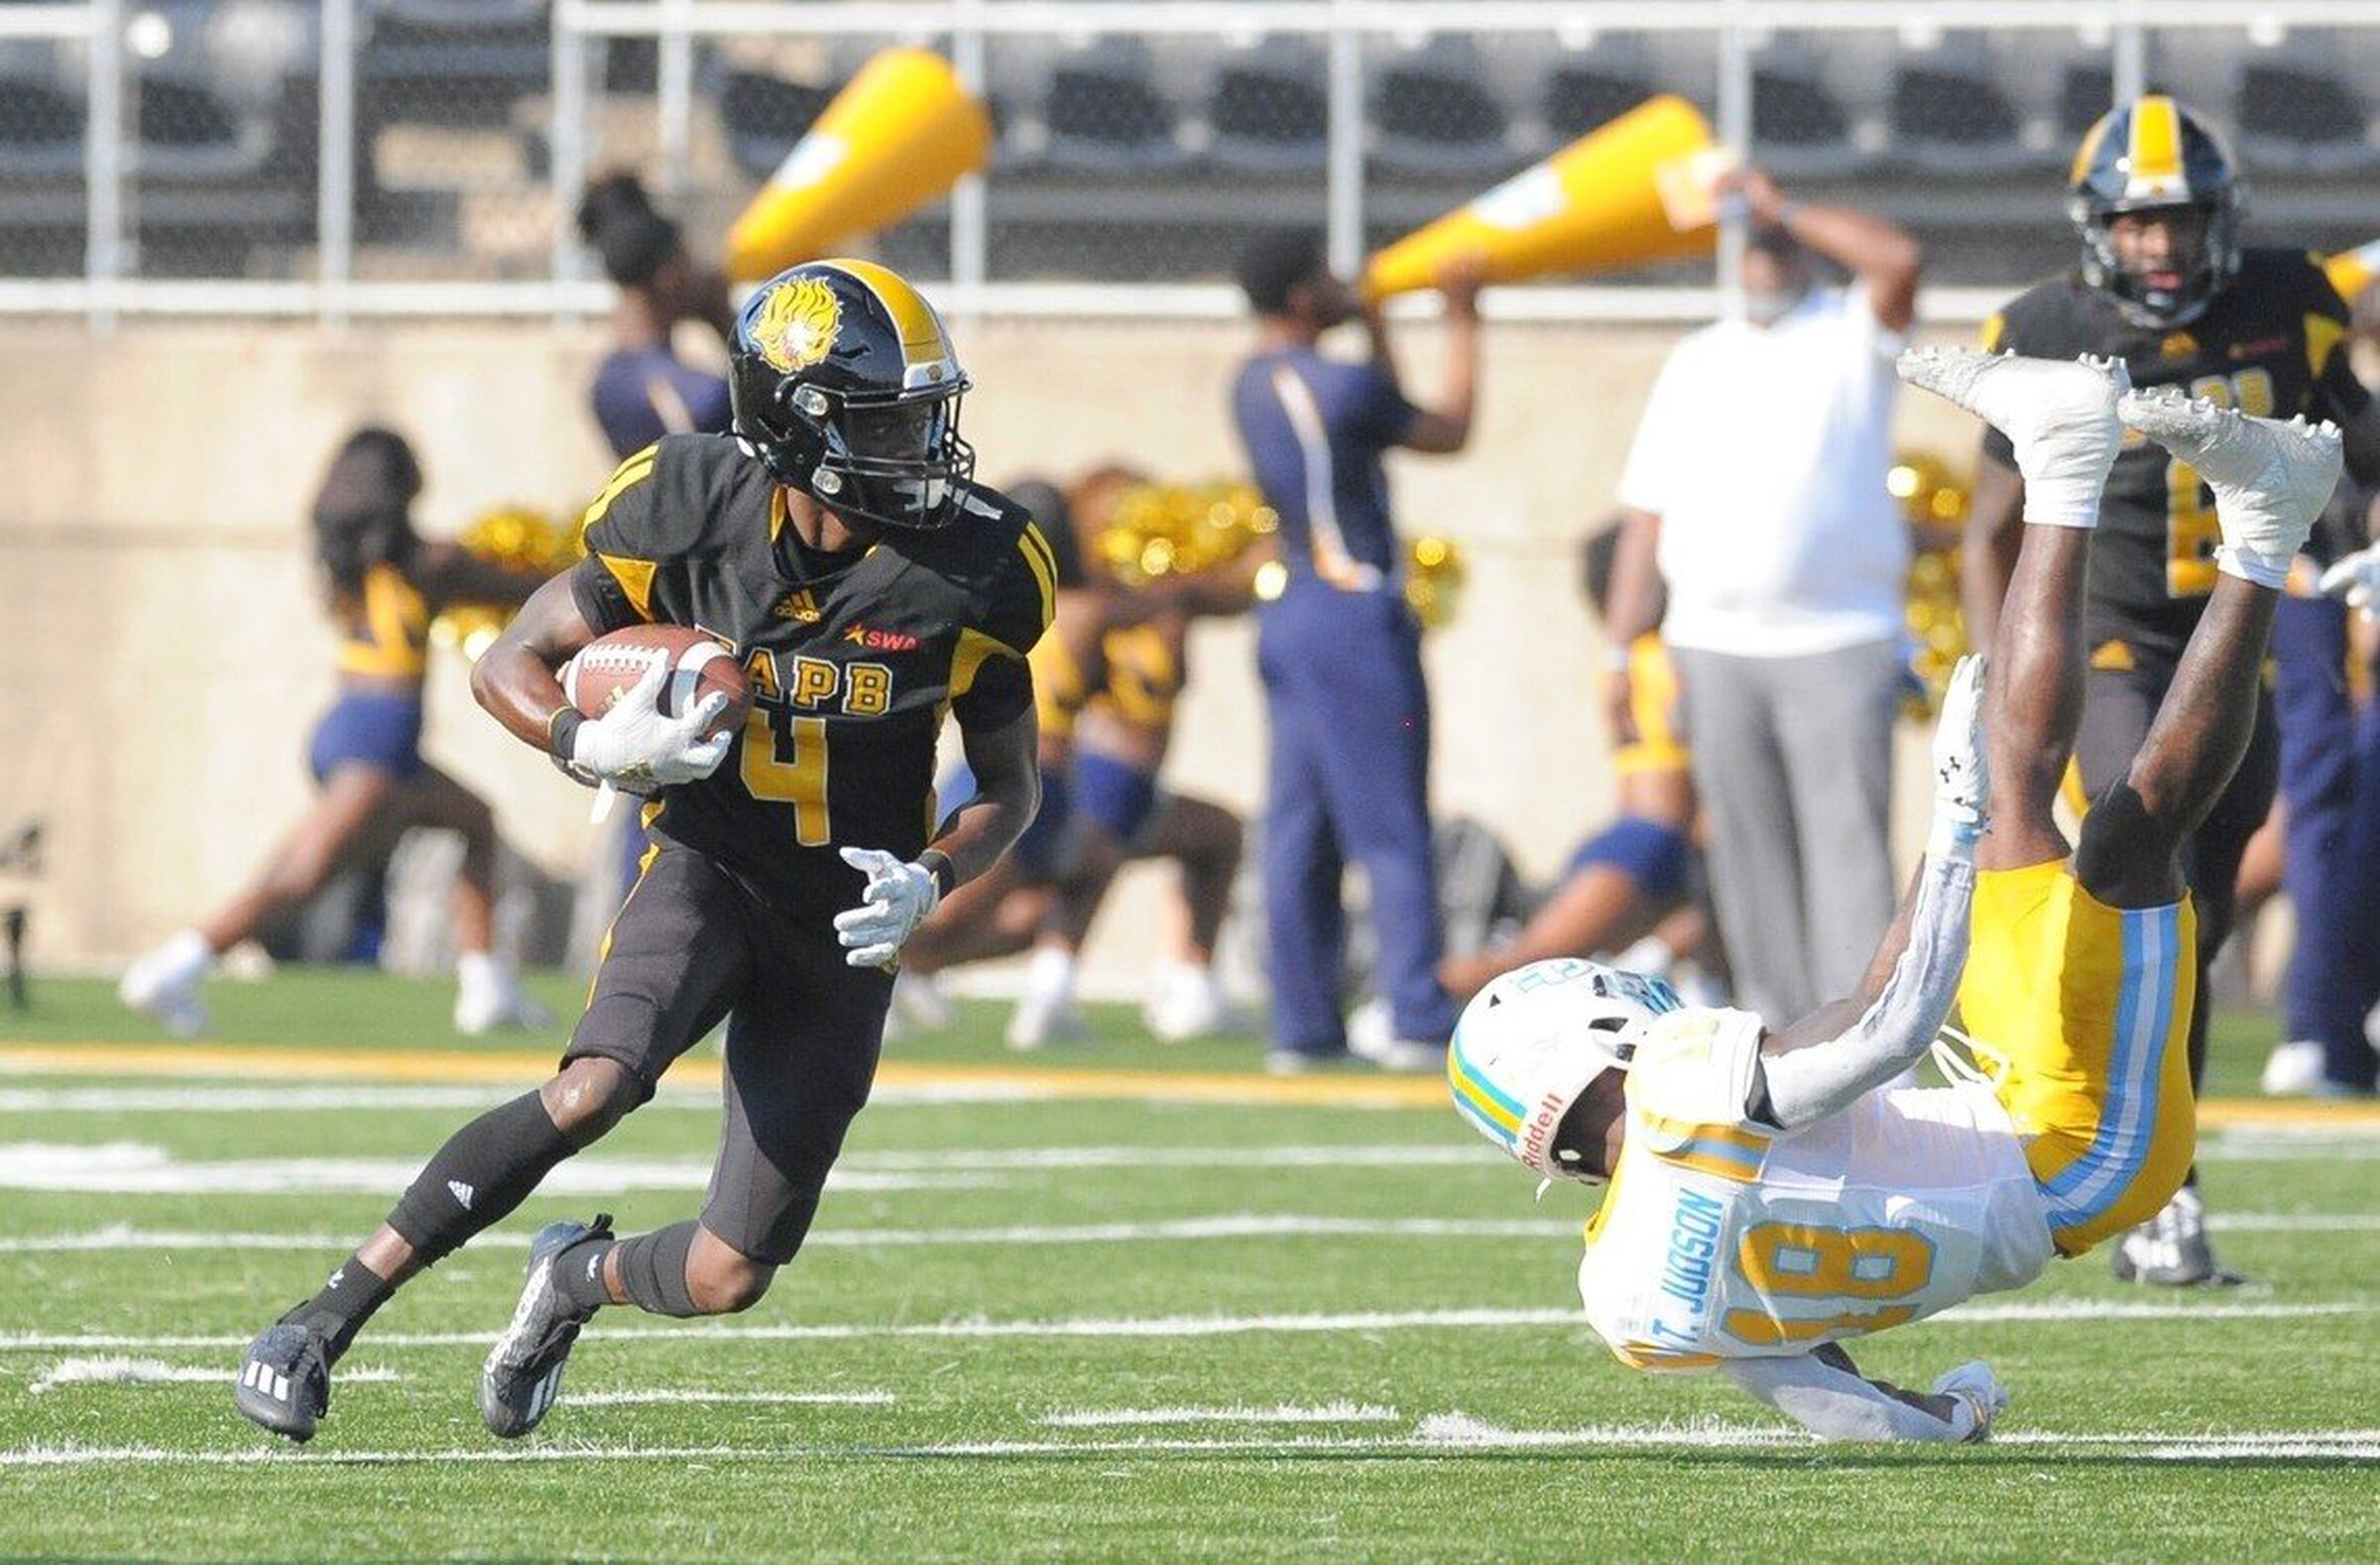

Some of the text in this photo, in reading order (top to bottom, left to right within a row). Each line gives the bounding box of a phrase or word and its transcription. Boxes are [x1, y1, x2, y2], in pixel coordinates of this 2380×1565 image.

[694, 623, 892, 715] APB
[740, 706, 831, 848] 4
[1520, 1092, 1565, 1168] Riddell
[1660, 1187, 1724, 1313] JUDSON
[1721, 1218, 1937, 1347] 18
